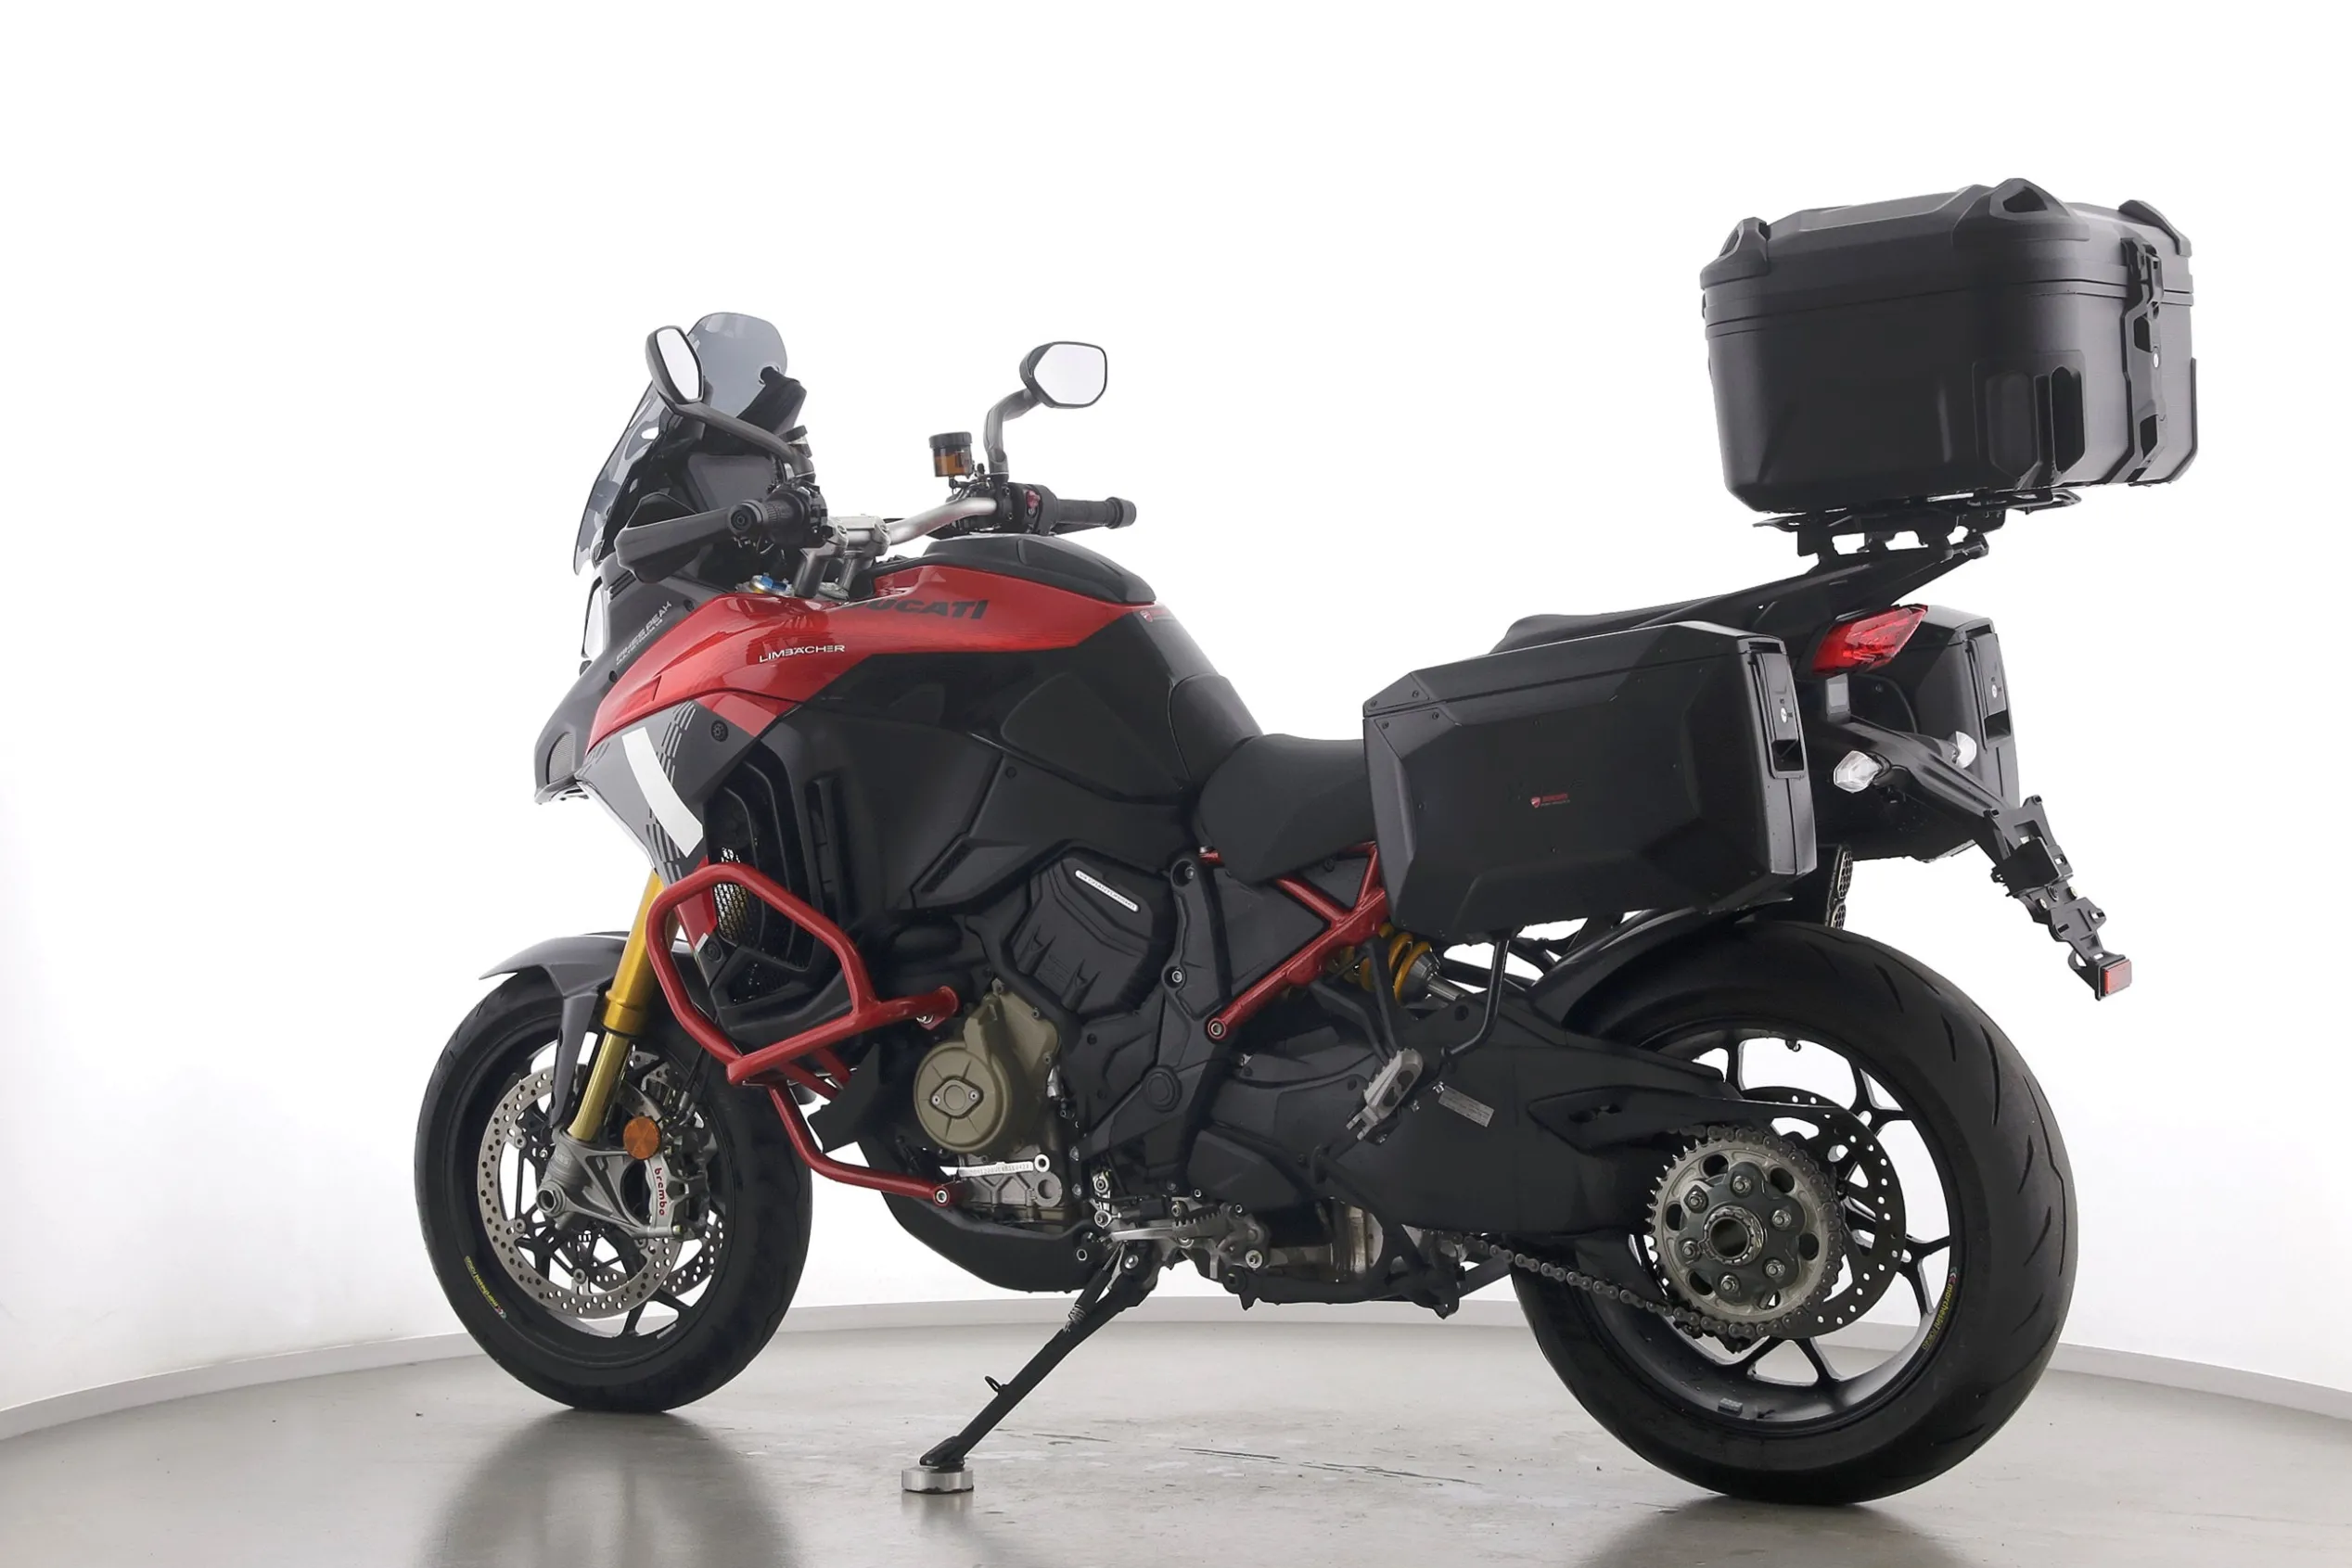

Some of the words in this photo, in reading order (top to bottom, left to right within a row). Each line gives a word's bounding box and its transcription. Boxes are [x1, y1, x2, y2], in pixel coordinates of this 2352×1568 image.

[646, 601, 672, 631] PEAK
[842, 598, 990, 619] UCATI
[655, 1167, 667, 1216] brembo
